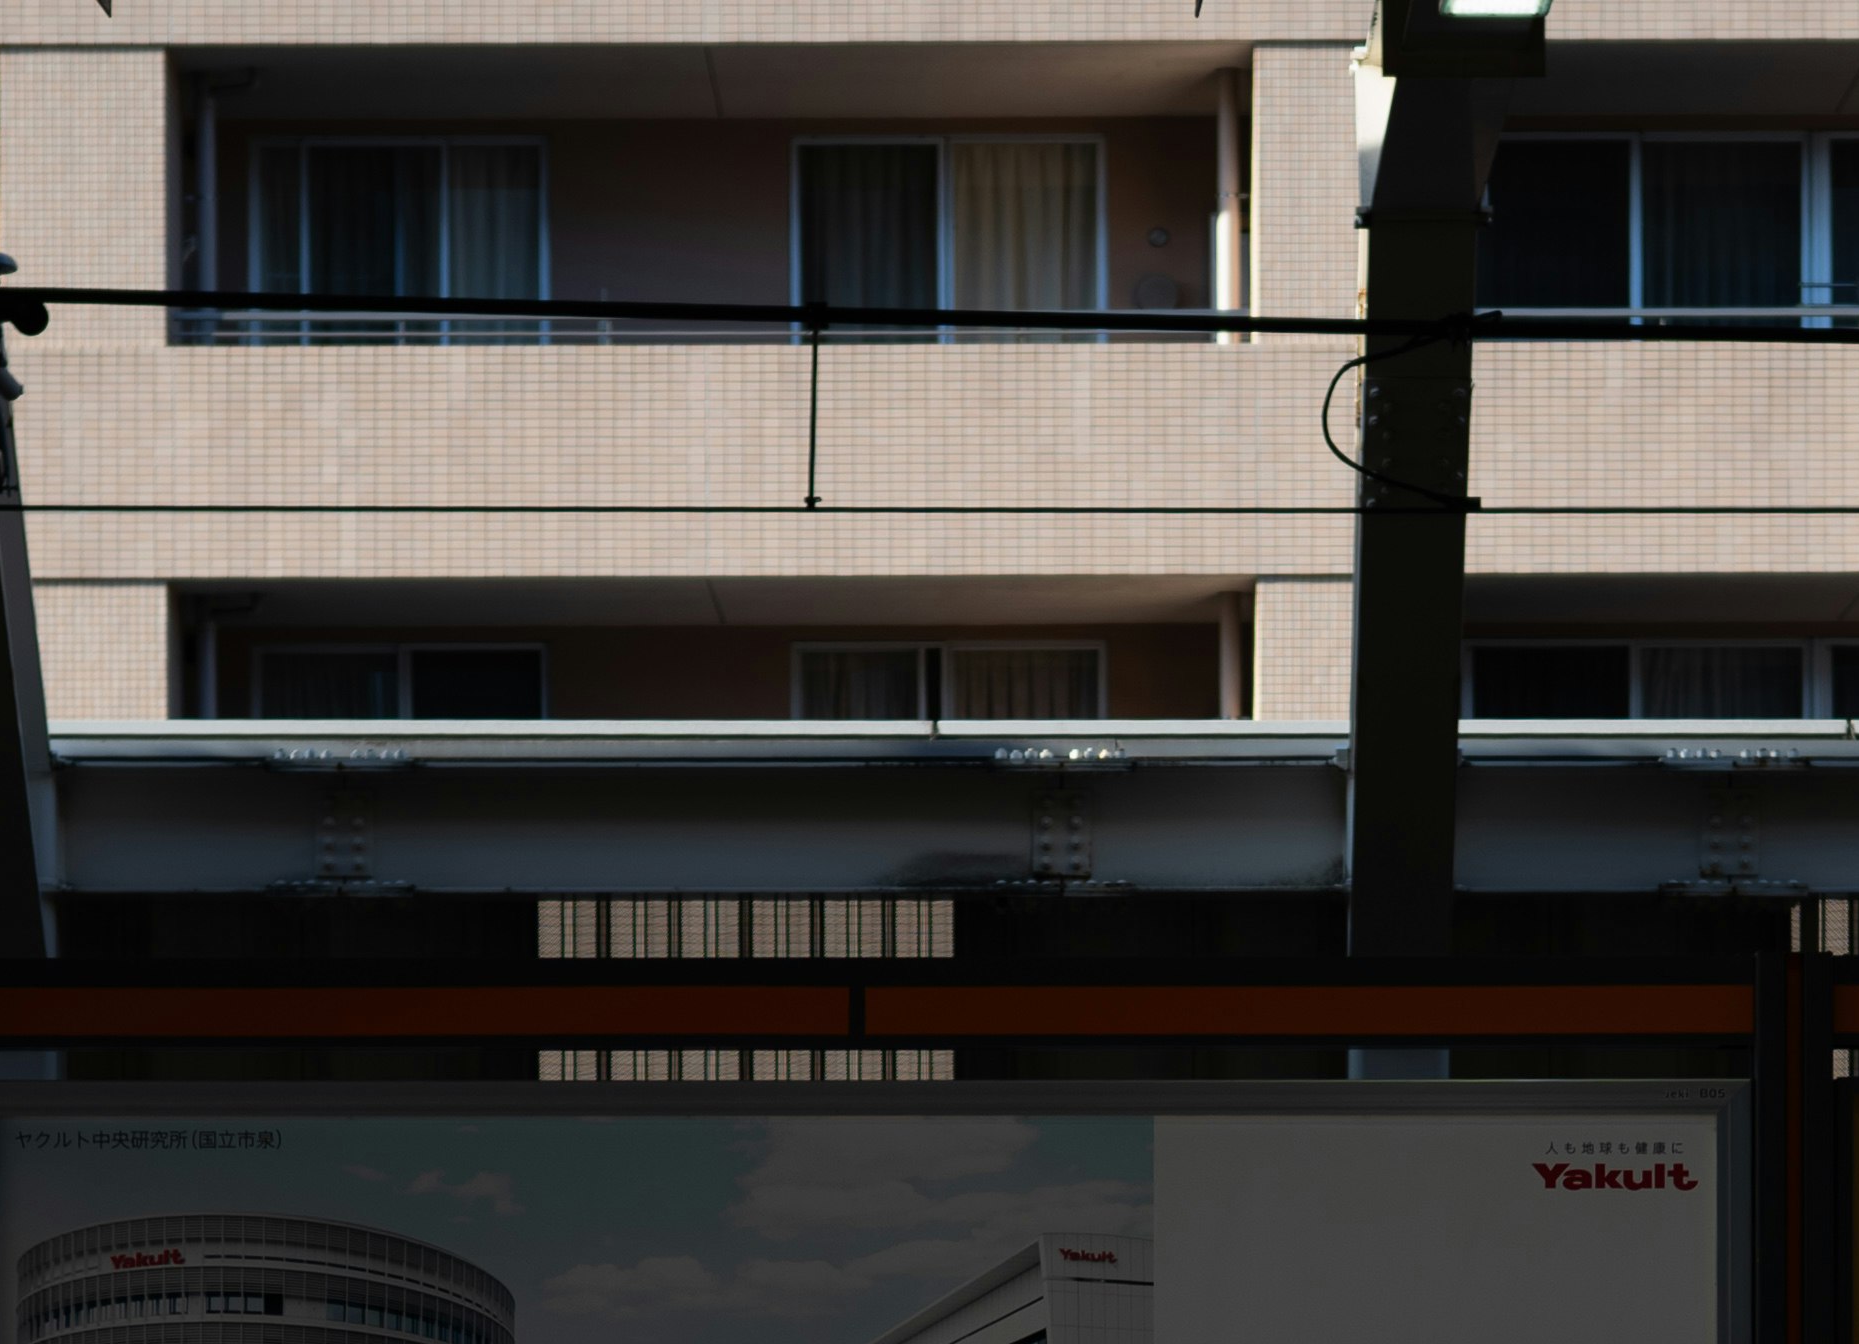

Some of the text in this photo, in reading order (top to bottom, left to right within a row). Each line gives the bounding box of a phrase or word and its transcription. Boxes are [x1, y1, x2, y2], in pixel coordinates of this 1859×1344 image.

[1544, 1141, 1685, 1155] 人も地球も健康に
[1532, 1163, 1698, 1191] Yakult
[111, 1249, 186, 1270] Yakult
[1059, 1248, 1118, 1263] Yakult
